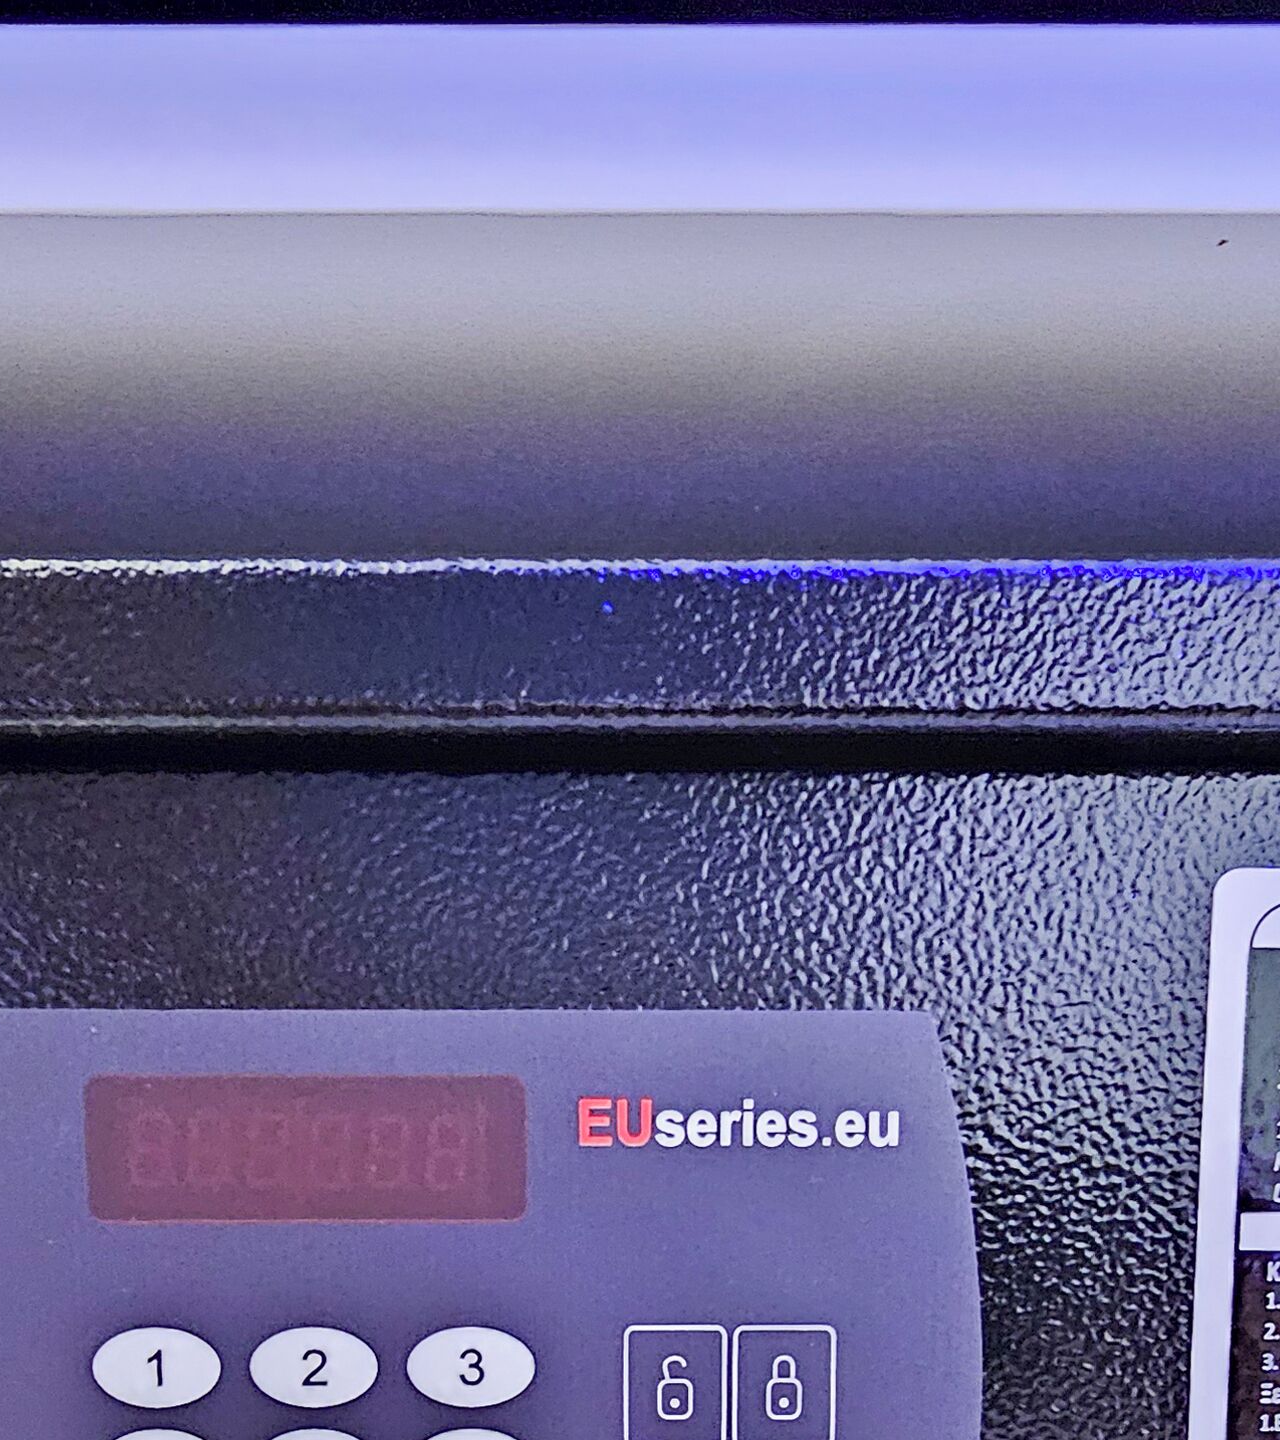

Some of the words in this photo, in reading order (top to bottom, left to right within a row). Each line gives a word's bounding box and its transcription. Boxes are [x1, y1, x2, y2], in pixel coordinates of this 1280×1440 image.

[578, 1098, 900, 1149] EUseries.eu
[1263, 1324, 1280, 1340] 2.
[146, 1350, 163, 1387] 1
[301, 1349, 329, 1387] 2
[458, 1348, 485, 1386] 3
[1262, 1354, 1279, 1371] 3.
